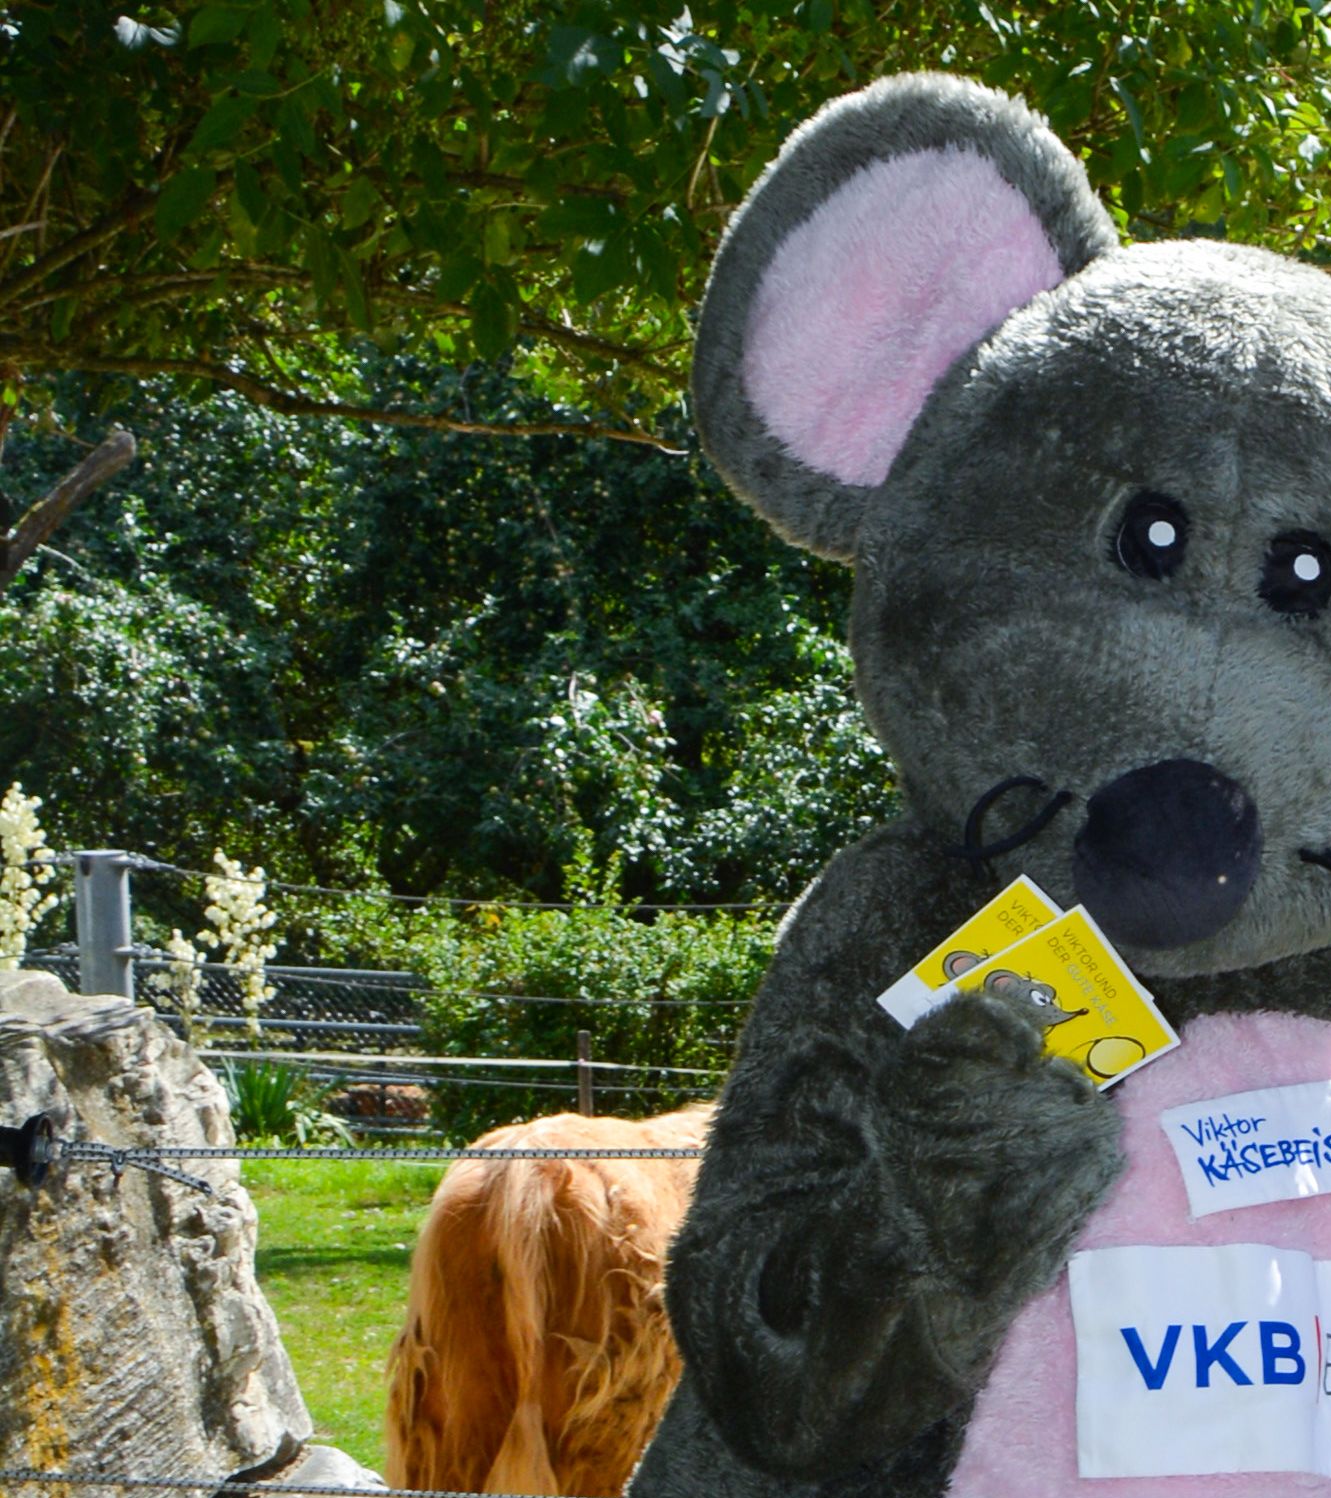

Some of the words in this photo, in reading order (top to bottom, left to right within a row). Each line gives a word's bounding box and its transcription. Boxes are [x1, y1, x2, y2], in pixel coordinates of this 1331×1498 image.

[997, 910, 1024, 936] DER
[1047, 937, 1071, 963] DER
[1062, 928, 1099, 972] VIKTOR
[1094, 972, 1117, 1000] UND
[1182, 1114, 1268, 1148] Viktor
[1120, 1320, 1307, 1391] VKB
